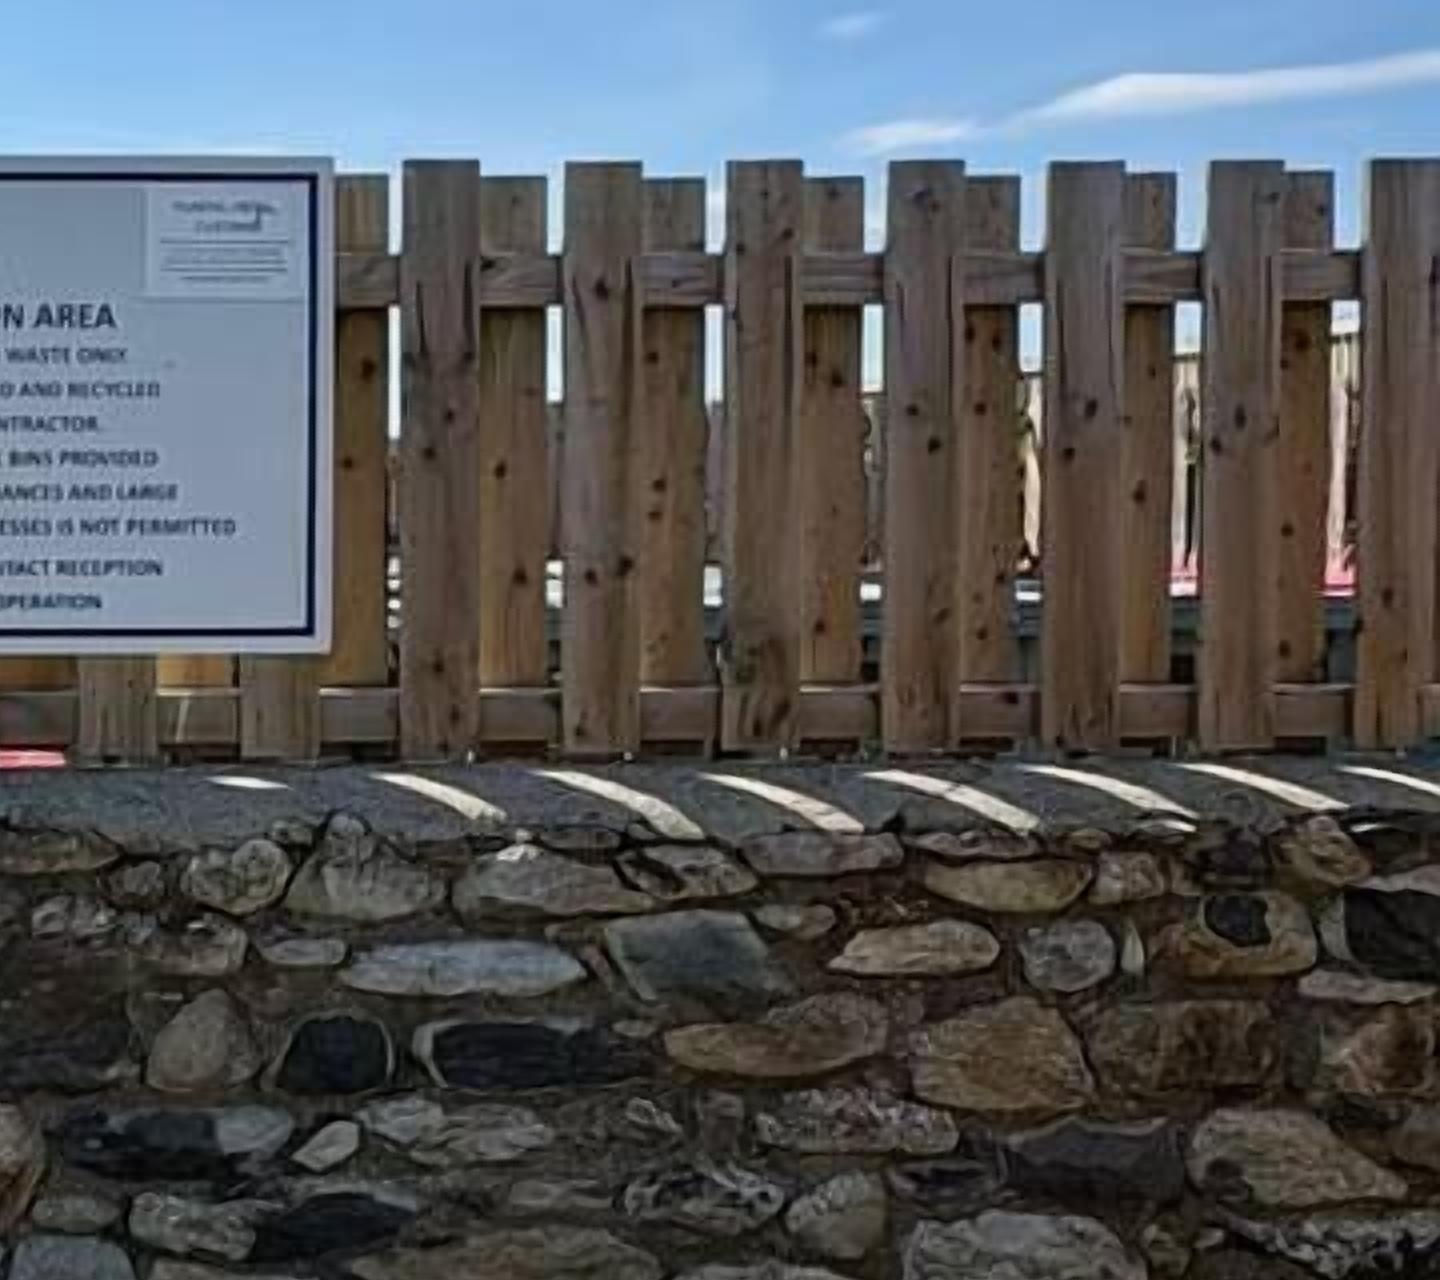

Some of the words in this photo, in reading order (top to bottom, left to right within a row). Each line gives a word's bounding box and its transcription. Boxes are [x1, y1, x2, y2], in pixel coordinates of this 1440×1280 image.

[33, 303, 118, 329] AREA
[6, 347, 70, 364] WASTE
[18, 381, 61, 398] AND
[67, 381, 160, 398] RECYCLED
[9, 450, 53, 467] BINS
[60, 450, 159, 467] PROVIDED
[67, 484, 111, 501] AND
[116, 484, 178, 501] LARGE
[56, 518, 73, 536] IS
[79, 518, 119, 536] NOT
[127, 518, 236, 536] PERMITTED
[56, 559, 163, 577] RECEPTION
